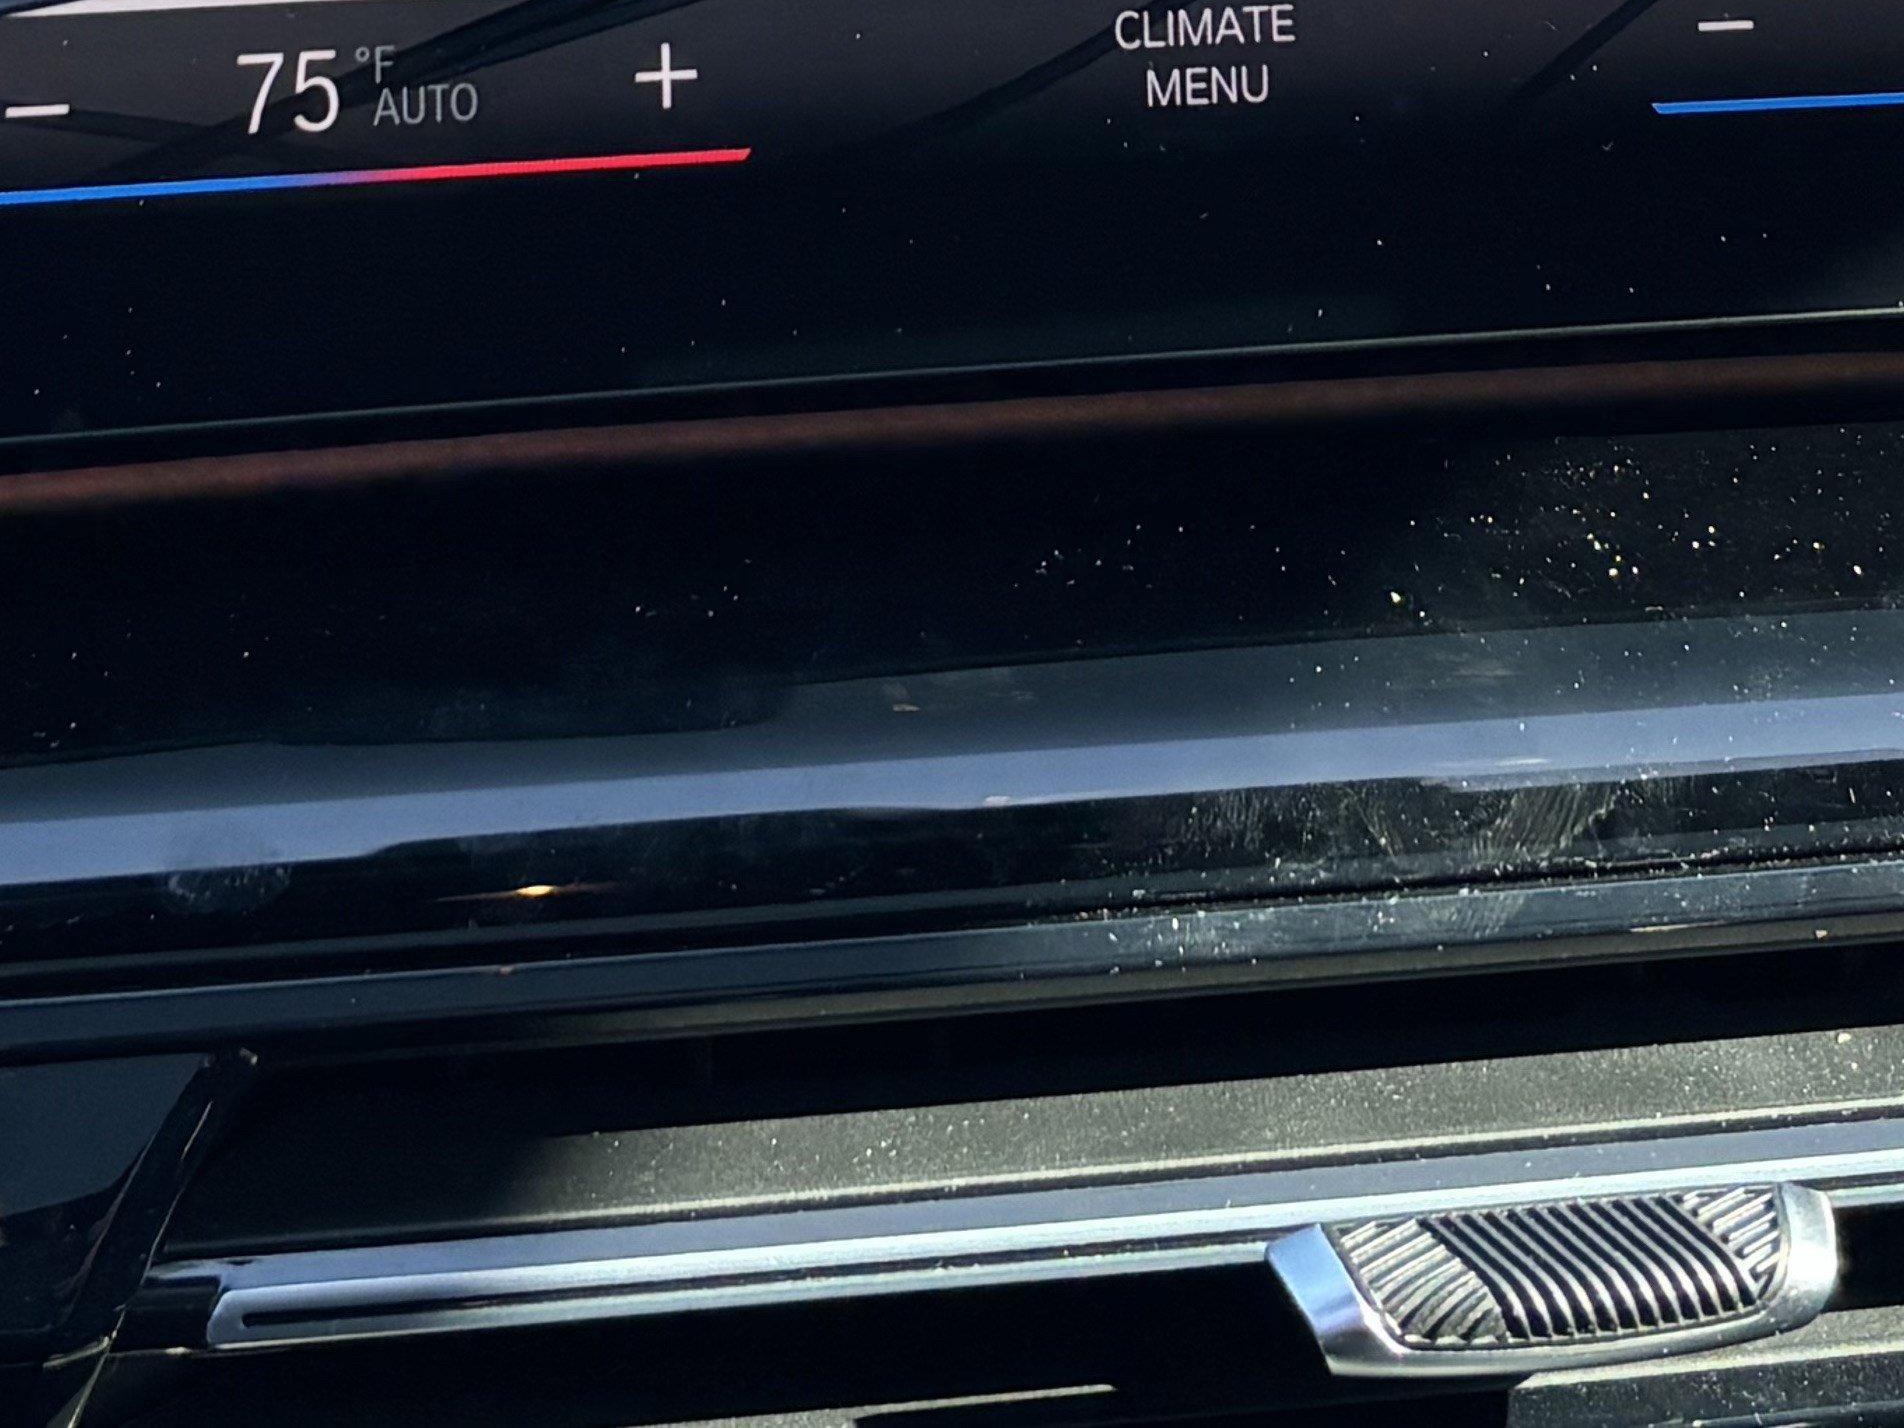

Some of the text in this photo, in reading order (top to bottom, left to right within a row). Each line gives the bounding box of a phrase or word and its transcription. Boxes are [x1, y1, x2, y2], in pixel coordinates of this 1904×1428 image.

[1113, 2, 1297, 51] CLIMATE
[235, 48, 340, 135] 75
[371, 83, 479, 128] AUTO
[1145, 63, 1270, 108] MENU
